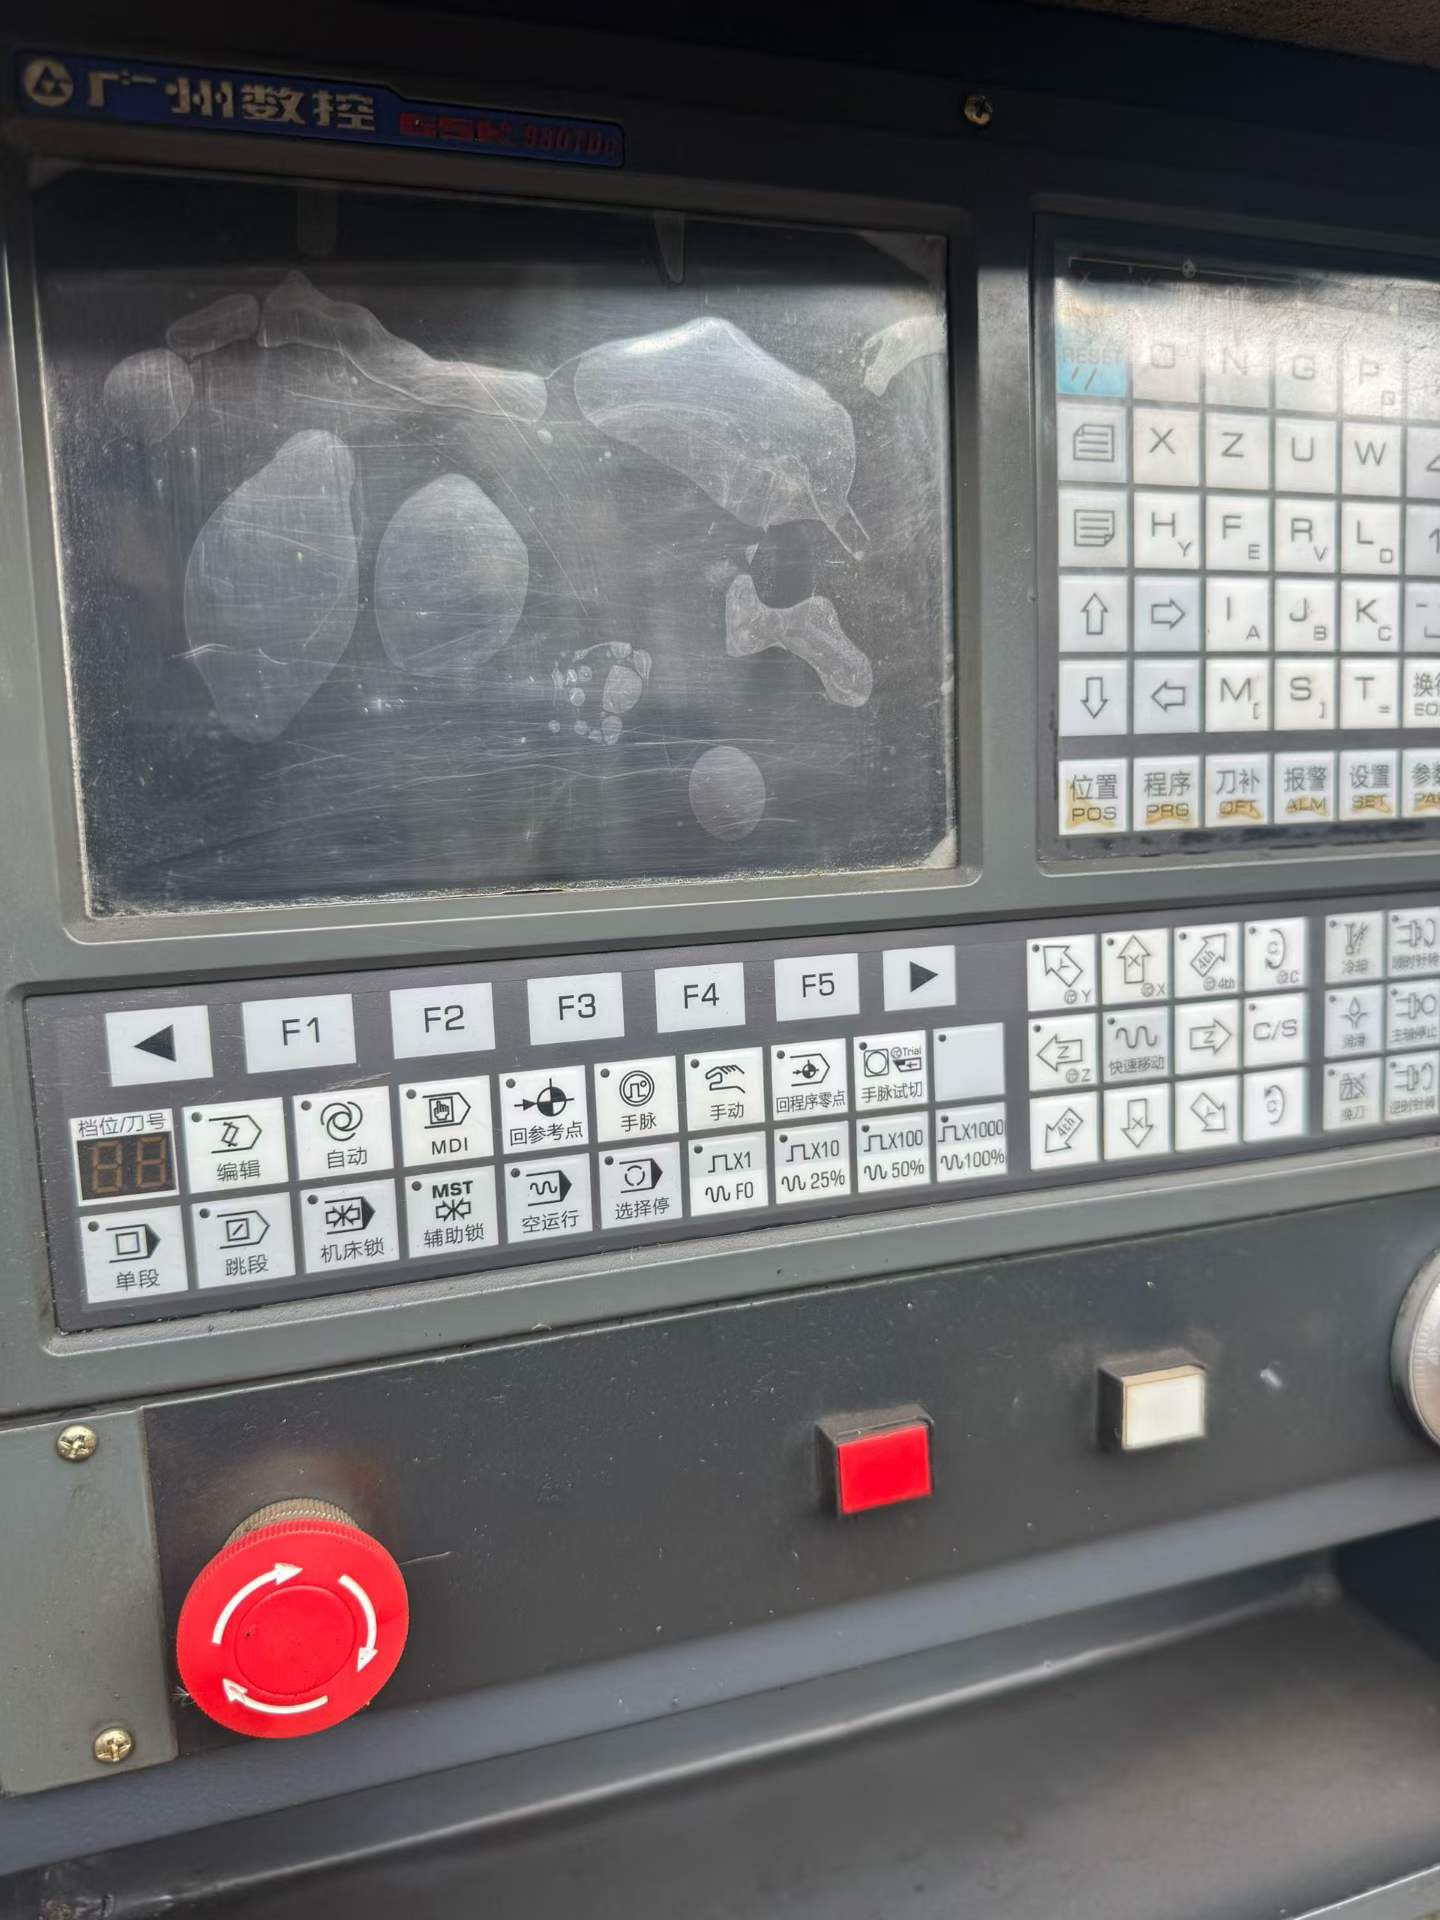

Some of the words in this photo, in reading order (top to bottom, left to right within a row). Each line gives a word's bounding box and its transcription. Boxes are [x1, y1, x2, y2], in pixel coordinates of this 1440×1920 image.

[88, 71, 376, 131] 广州数控
[1222, 347, 1248, 375] N
[1292, 356, 1315, 381] G
[1359, 357, 1379, 383] P
[1149, 428, 1175, 454] X
[1221, 432, 1244, 457] Z
[1292, 436, 1315, 462] U
[1354, 441, 1386, 466] W
[1152, 512, 1175, 537] H
[1223, 515, 1242, 539] F
[1291, 518, 1312, 541] R
[1357, 520, 1374, 544] L
[1178, 542, 1192, 557] Y
[1248, 544, 1260, 560] E
[1313, 546, 1327, 561] V
[1289, 598, 1308, 622] J
[1356, 599, 1377, 623] K
[1246, 626, 1260, 640] A
[1313, 626, 1327, 640] B
[1378, 627, 1391, 641] C
[1220, 677, 1252, 701] M
[1290, 678, 1312, 701] S
[1354, 678, 1375, 700] T
[1414, 703, 1440, 717] EO
[1070, 774, 1118, 801] 位置
[1144, 771, 1191, 798] 程序
[1216, 768, 1260, 795] 刀补
[1284, 766, 1328, 793] 报警
[1350, 764, 1392, 790] 设置
[1146, 803, 1189, 818] PRG
[1287, 797, 1326, 813] ALM
[1352, 794, 1388, 810] SET
[1071, 807, 1117, 822] POS
[1128, 954, 1141, 967] X
[683, 983, 720, 1009] F4
[801, 972, 836, 998] F5
[559, 993, 597, 1021] F3
[423, 1005, 465, 1033] F2
[1253, 1018, 1297, 1041] C/S
[282, 1016, 321, 1047] F1
[1203, 1031, 1215, 1044] Z
[903, 1047, 922, 1057] Trial
[1057, 1046, 1069, 1059] Z
[1110, 1056, 1164, 1075] 快速移动
[776, 1089, 846, 1113] 回程序零点
[861, 1081, 923, 1104] 手脉试切
[621, 1113, 658, 1133] 手脉
[710, 1102, 745, 1121] 手动
[1131, 1116, 1144, 1130] X
[78, 1113, 166, 1138] 档位/刀号
[509, 1121, 584, 1146] 回参考点
[961, 1119, 1005, 1140] X1000
[431, 1137, 469, 1156] MDI
[811, 1140, 840, 1160] X10
[888, 1129, 923, 1150] X100
[327, 1145, 368, 1169] 自动
[733, 1151, 752, 1170] X1
[892, 1159, 925, 1178] 50%
[964, 1149, 1005, 1168] 100%
[216, 1159, 262, 1182] 编辑
[810, 1169, 846, 1190] 25%
[432, 1180, 474, 1196] MST
[735, 1182, 754, 1200] F0
[616, 1198, 670, 1220] 选择停
[521, 1210, 579, 1234] 空运行
[423, 1223, 485, 1248] 辅助锁
[321, 1236, 385, 1262] 机床锁
[225, 1253, 269, 1276] 跳段
[115, 1269, 160, 1290] 单段
